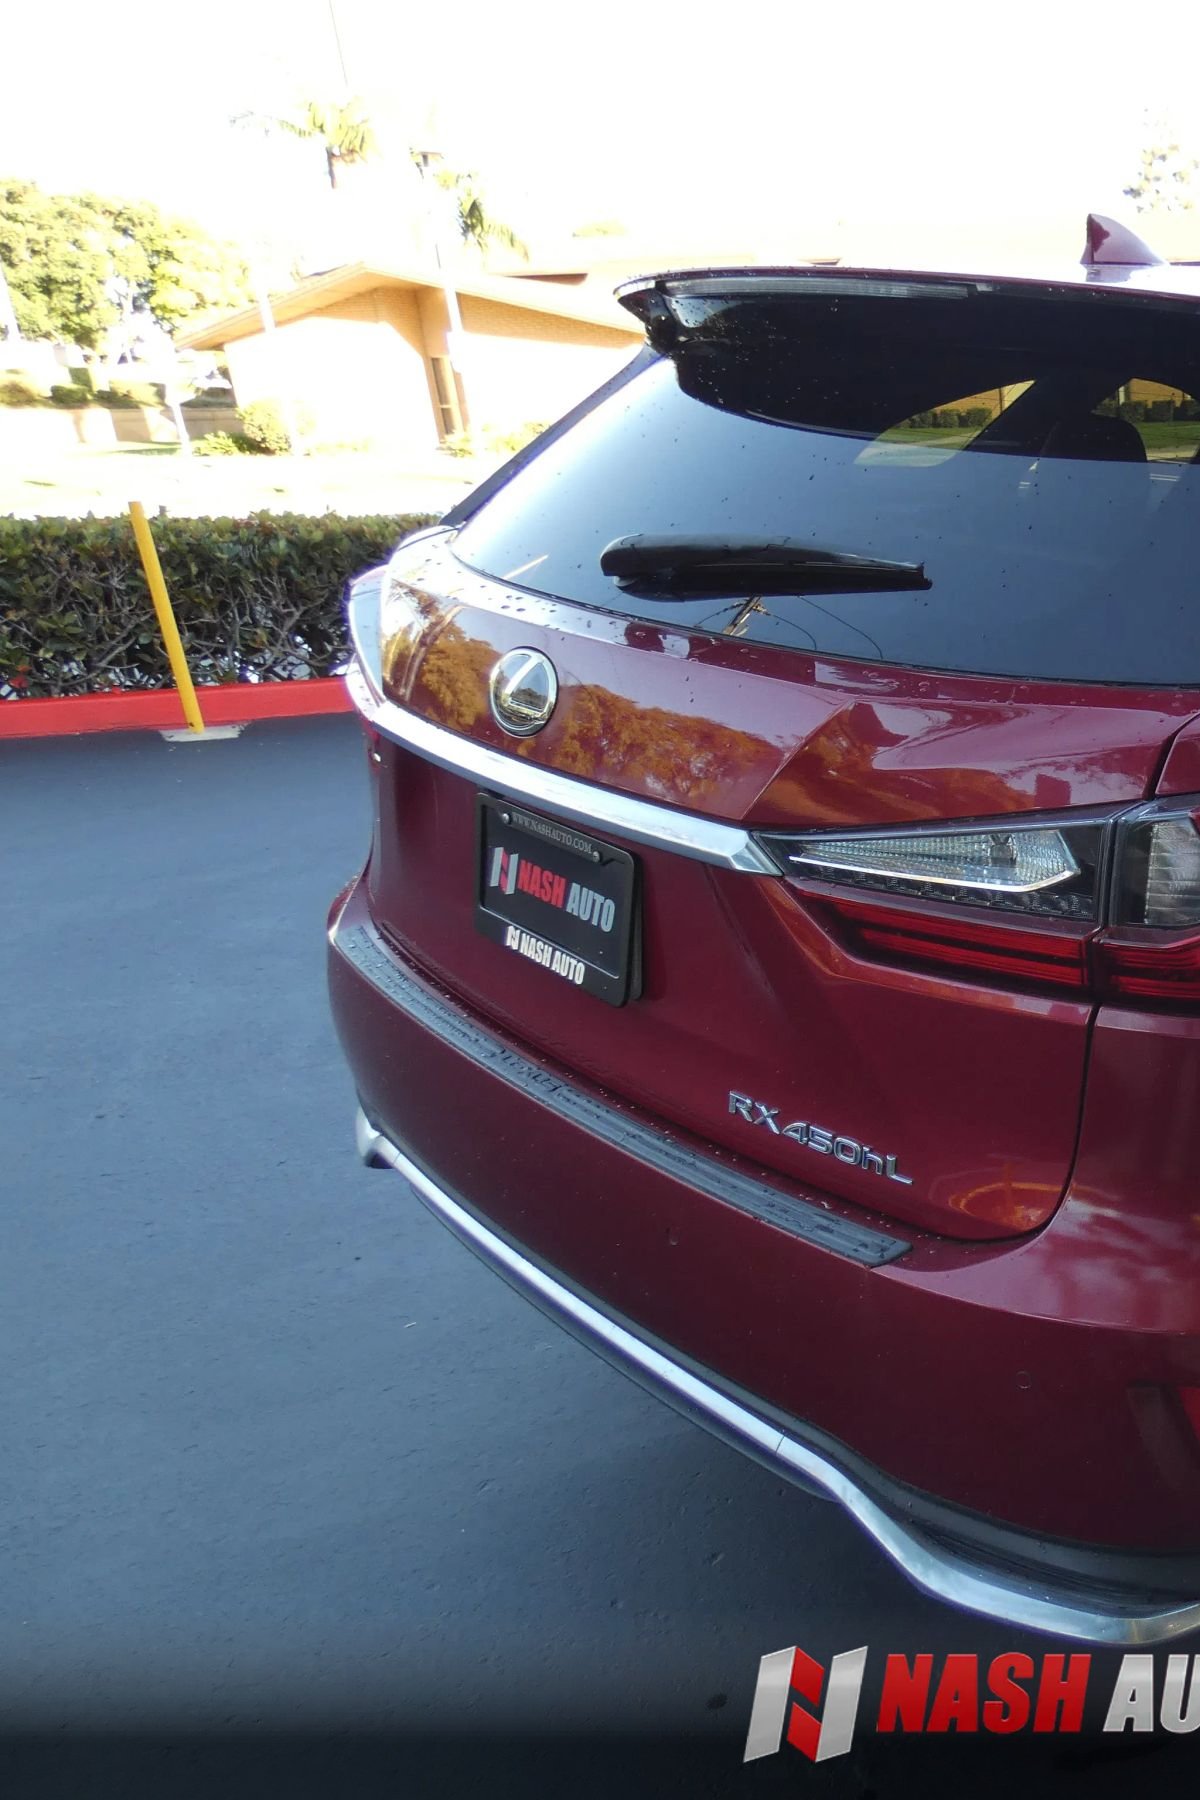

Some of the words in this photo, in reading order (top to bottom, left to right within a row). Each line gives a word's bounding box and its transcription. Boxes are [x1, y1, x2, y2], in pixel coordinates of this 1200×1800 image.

[511, 811, 593, 855] WWW.NASHAUTO.COM
[516, 859, 567, 908] NASH
[566, 882, 616, 932] AUTO
[519, 932, 553, 968] NASH
[551, 951, 586, 985] AUTO
